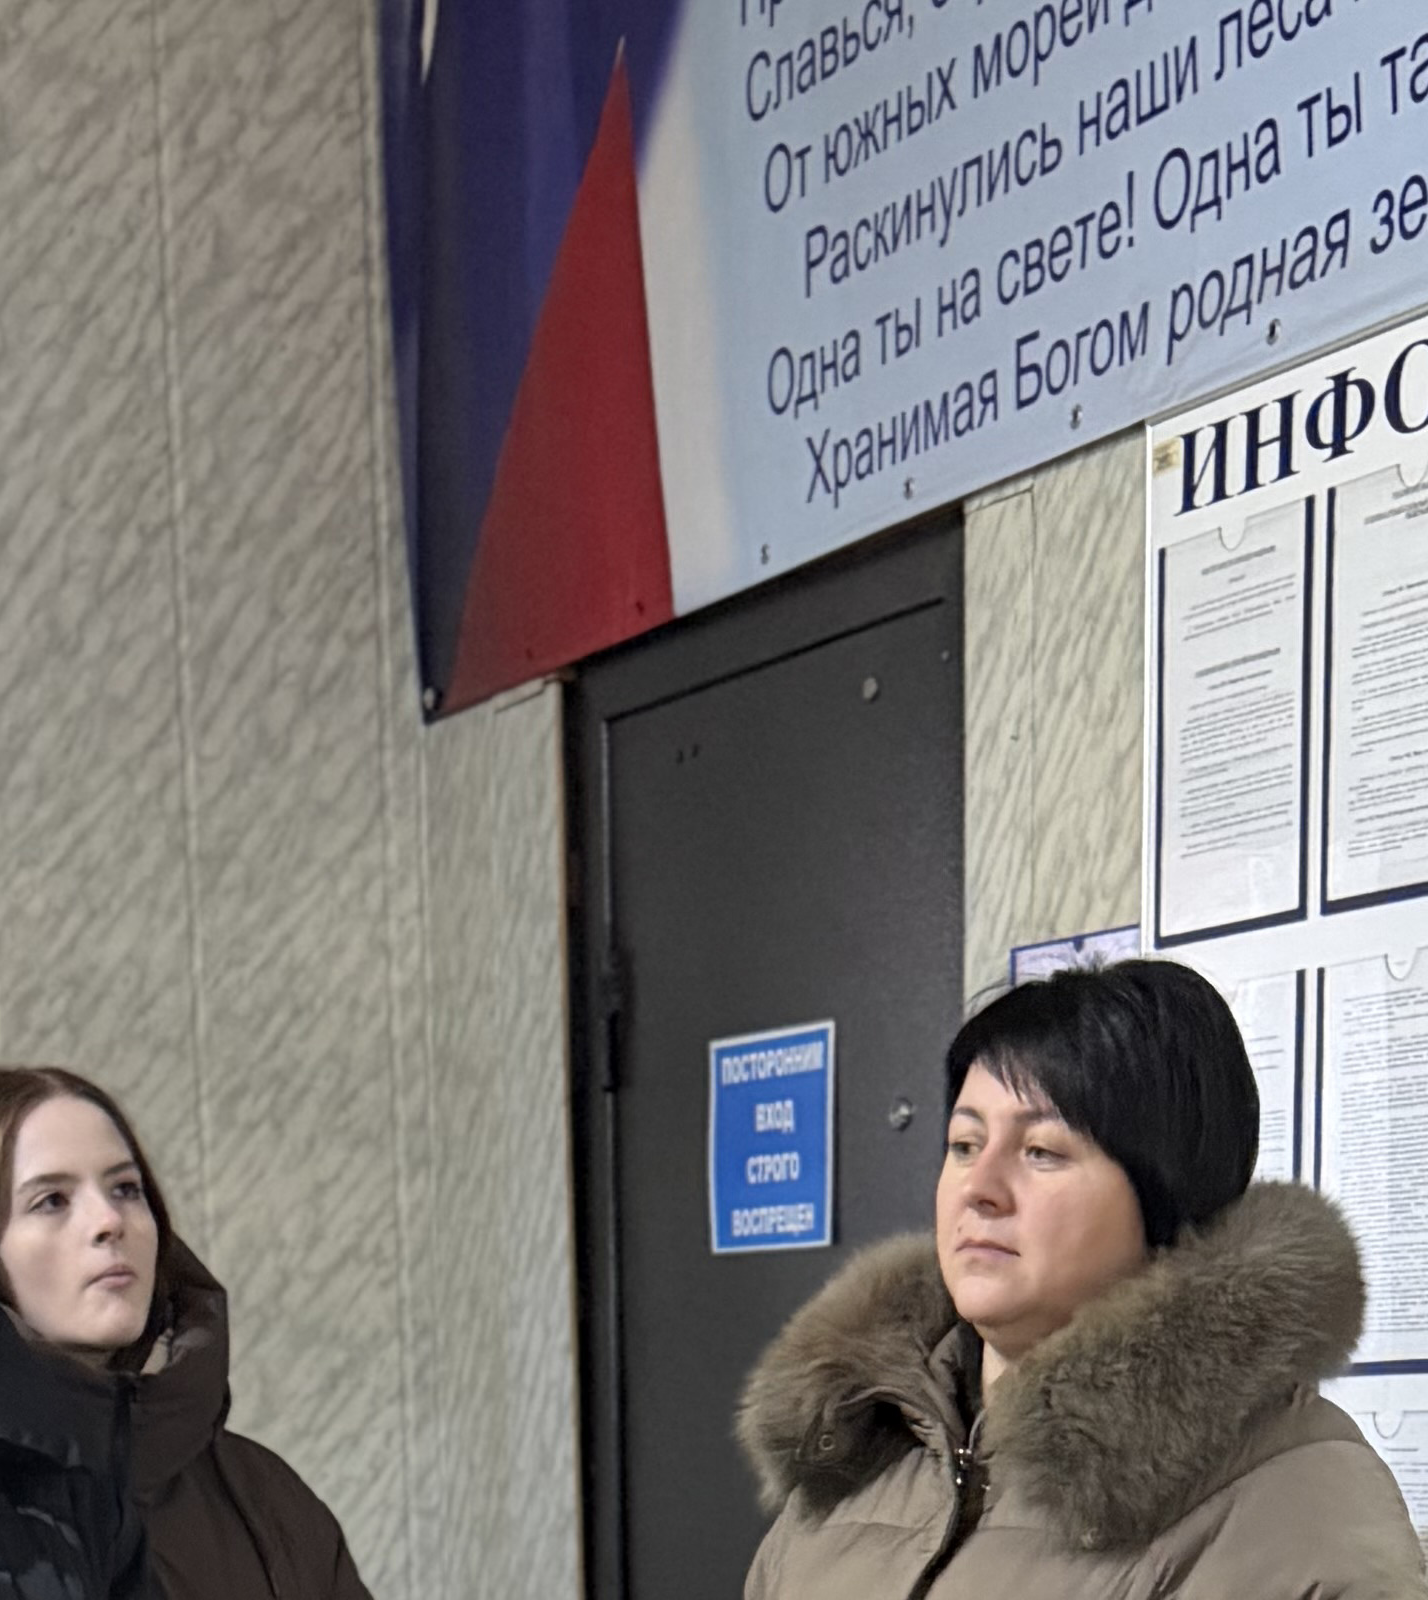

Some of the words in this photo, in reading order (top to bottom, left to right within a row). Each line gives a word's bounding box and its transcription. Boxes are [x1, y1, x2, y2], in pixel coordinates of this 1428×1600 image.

[745, 0, 914, 121] Славься,
[764, 142, 812, 213] От
[824, 57, 957, 184] южных
[804, 122, 1063, 298] Раскинулись
[1078, 36, 1199, 156] наши
[767, 328, 860, 419] Одна
[875, 298, 922, 365] ты
[937, 267, 981, 337] на
[996, 170, 1135, 305] свете!
[1153, 117, 1282, 233] Одна
[1296, 71, 1362, 158] ты
[805, 369, 999, 508] Хранимая
[1015, 301, 1150, 410] Богом
[1166, 208, 1351, 366] родная
[746, 1152, 800, 1184] СТРОГО
[755, 1099, 794, 1133] ВХОД
[731, 1203, 814, 1237] ВОСПРЕЩЕН
